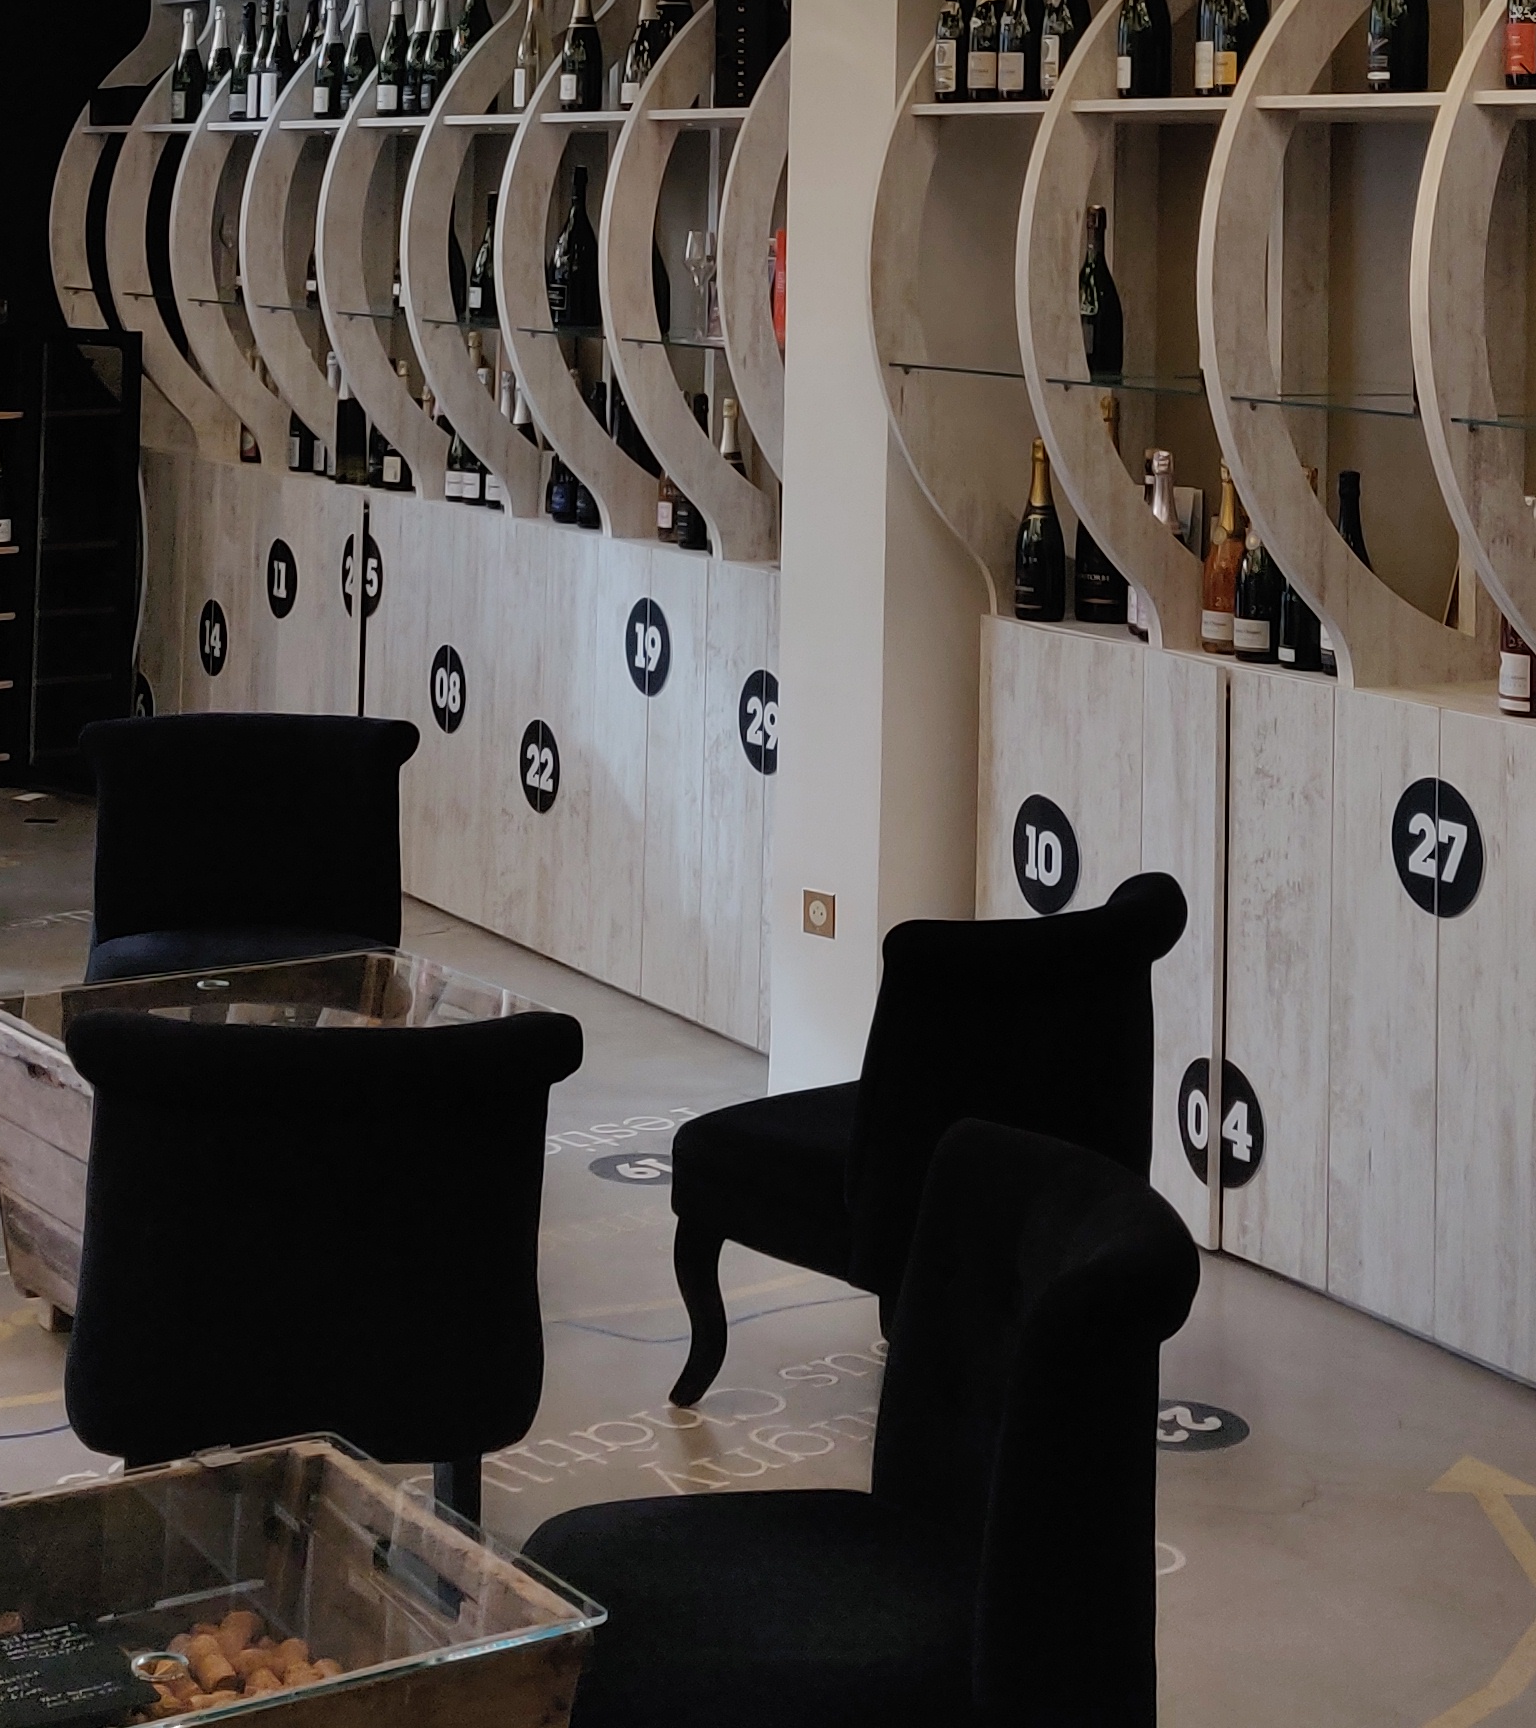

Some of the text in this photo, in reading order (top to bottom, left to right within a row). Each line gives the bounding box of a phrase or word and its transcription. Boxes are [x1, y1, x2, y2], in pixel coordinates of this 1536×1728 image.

[272, 560, 287, 599] 11
[204, 619, 221, 658] 14
[633, 622, 662, 672] 19
[435, 666, 461, 714] 08
[746, 696, 779, 750] 29
[525, 742, 554, 793] 22
[1024, 822, 1063, 888] 10
[1407, 811, 1468, 884] 27
[1186, 1089, 1253, 1163] 04
